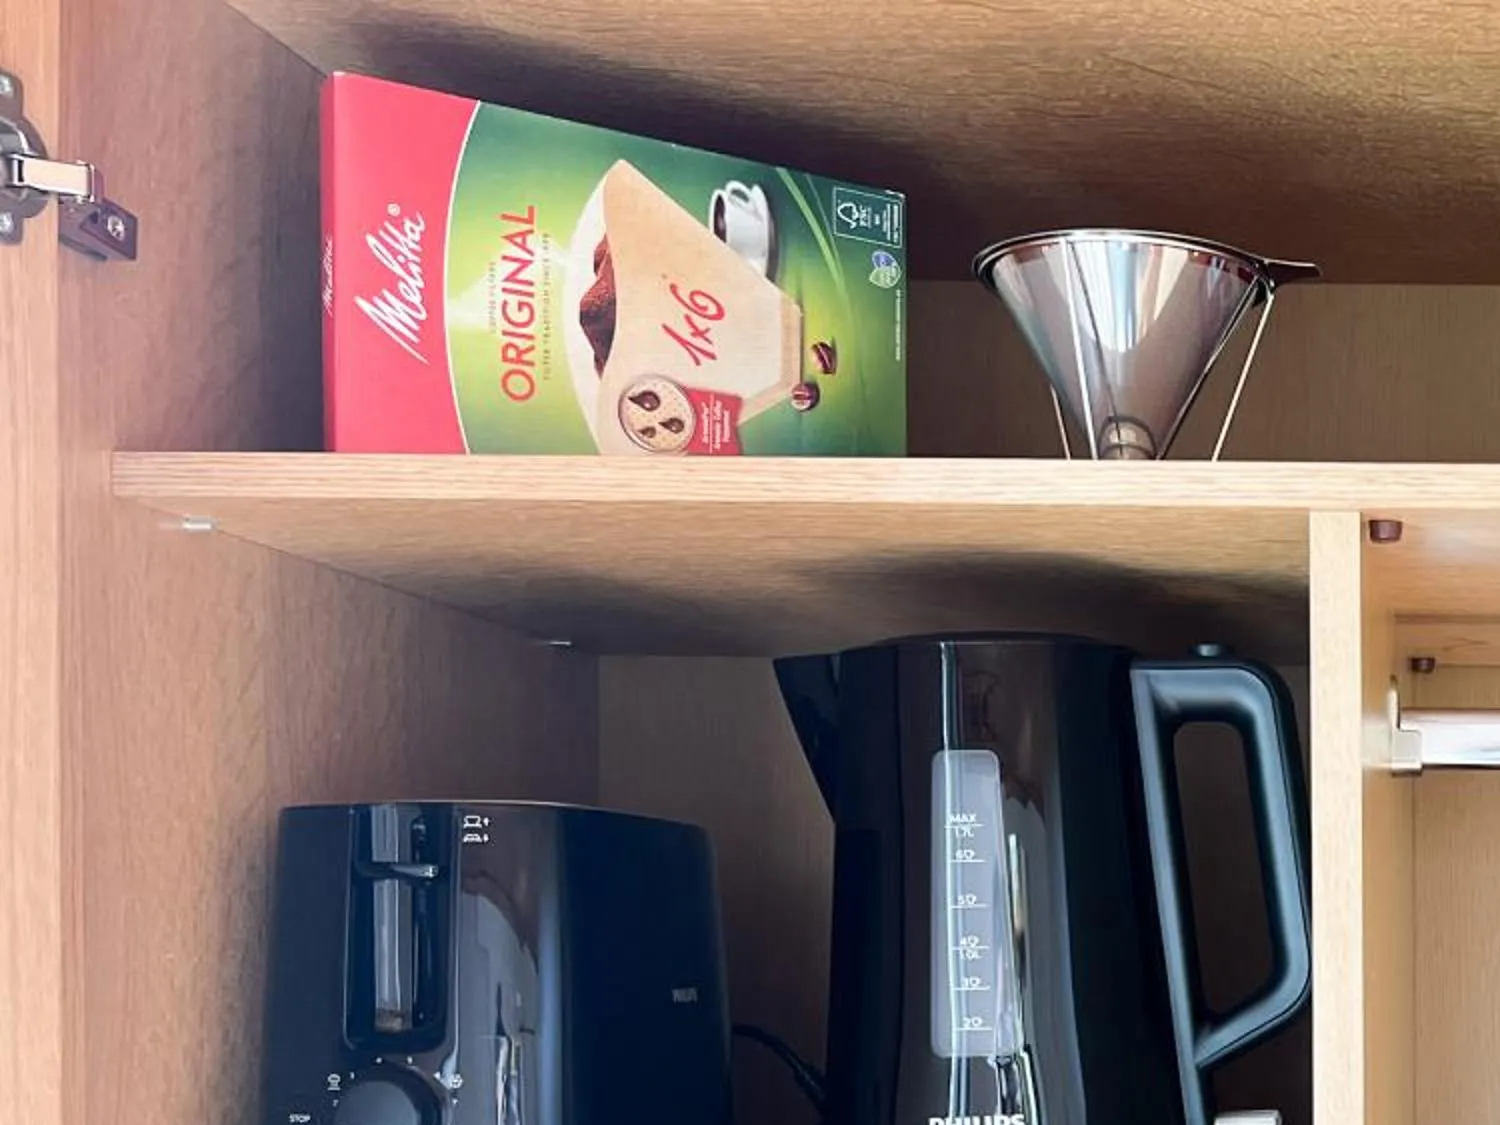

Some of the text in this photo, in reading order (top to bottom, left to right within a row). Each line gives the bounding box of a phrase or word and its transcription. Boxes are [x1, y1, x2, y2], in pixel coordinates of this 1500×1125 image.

[500, 205, 536, 403] ORIGINAL
[662, 284, 725, 366] 1x6
[951, 814, 977, 822] MAX
